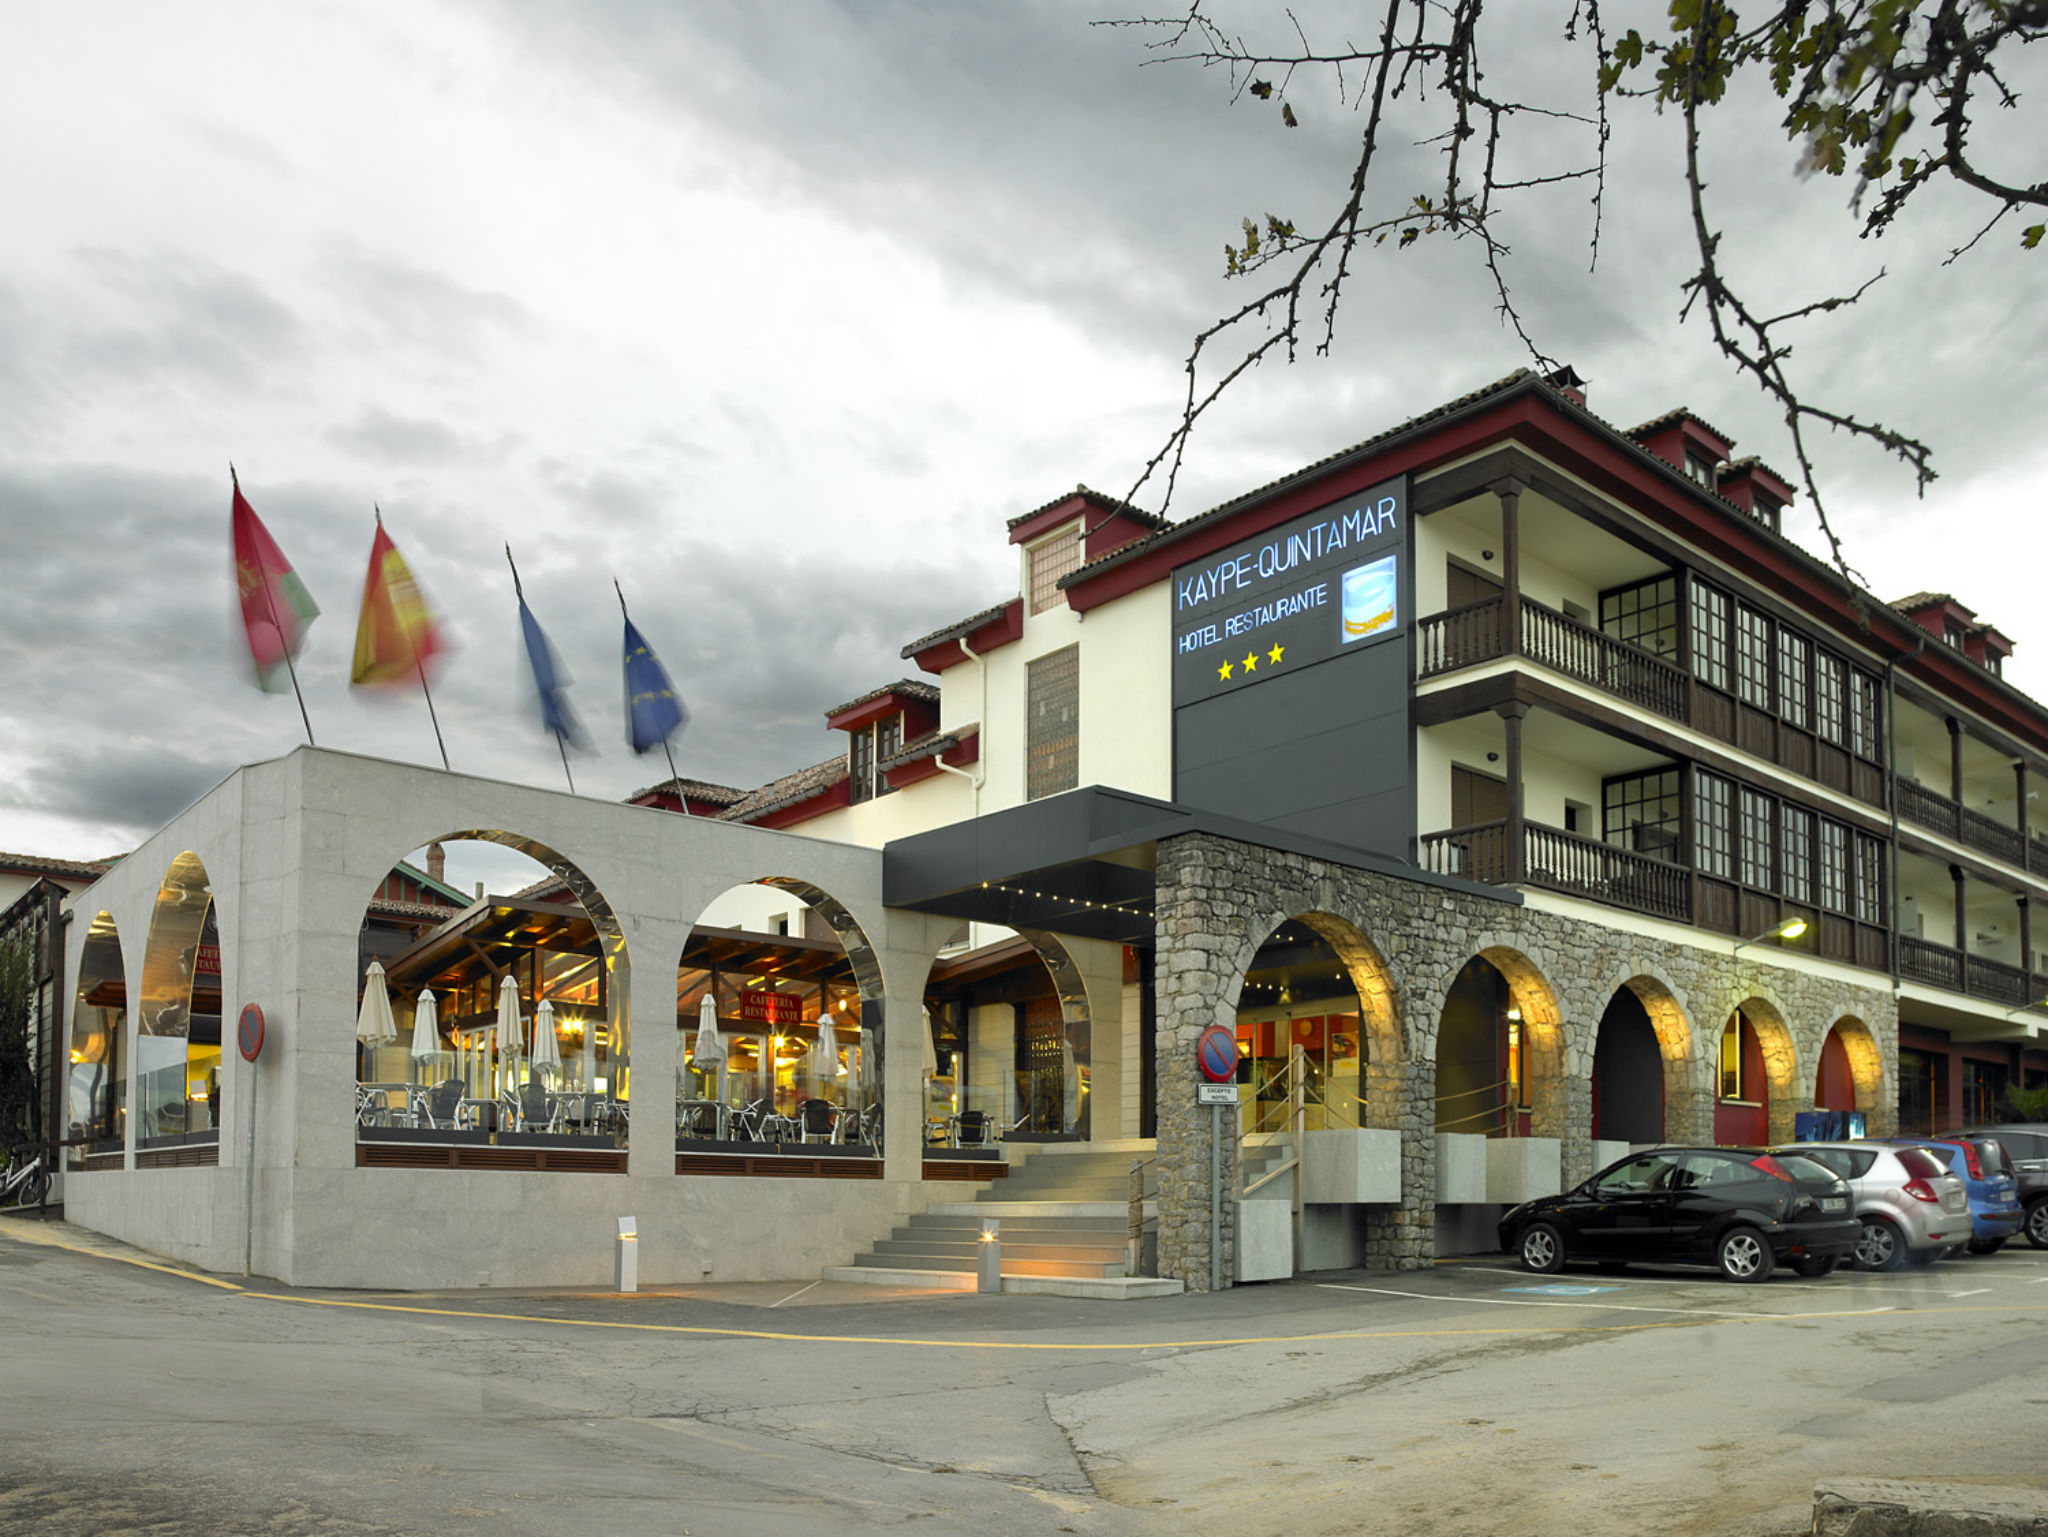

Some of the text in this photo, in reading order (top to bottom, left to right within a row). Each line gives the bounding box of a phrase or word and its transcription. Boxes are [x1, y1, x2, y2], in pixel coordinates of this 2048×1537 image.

[1179, 496, 1396, 611] KAYPE-QUINTAMAR
[1178, 583, 1328, 655] HOTEL RESTAURANTE
[745, 1006, 799, 1021] RESTAURANTE
[1207, 1087, 1232, 1095] EXCEPTO
